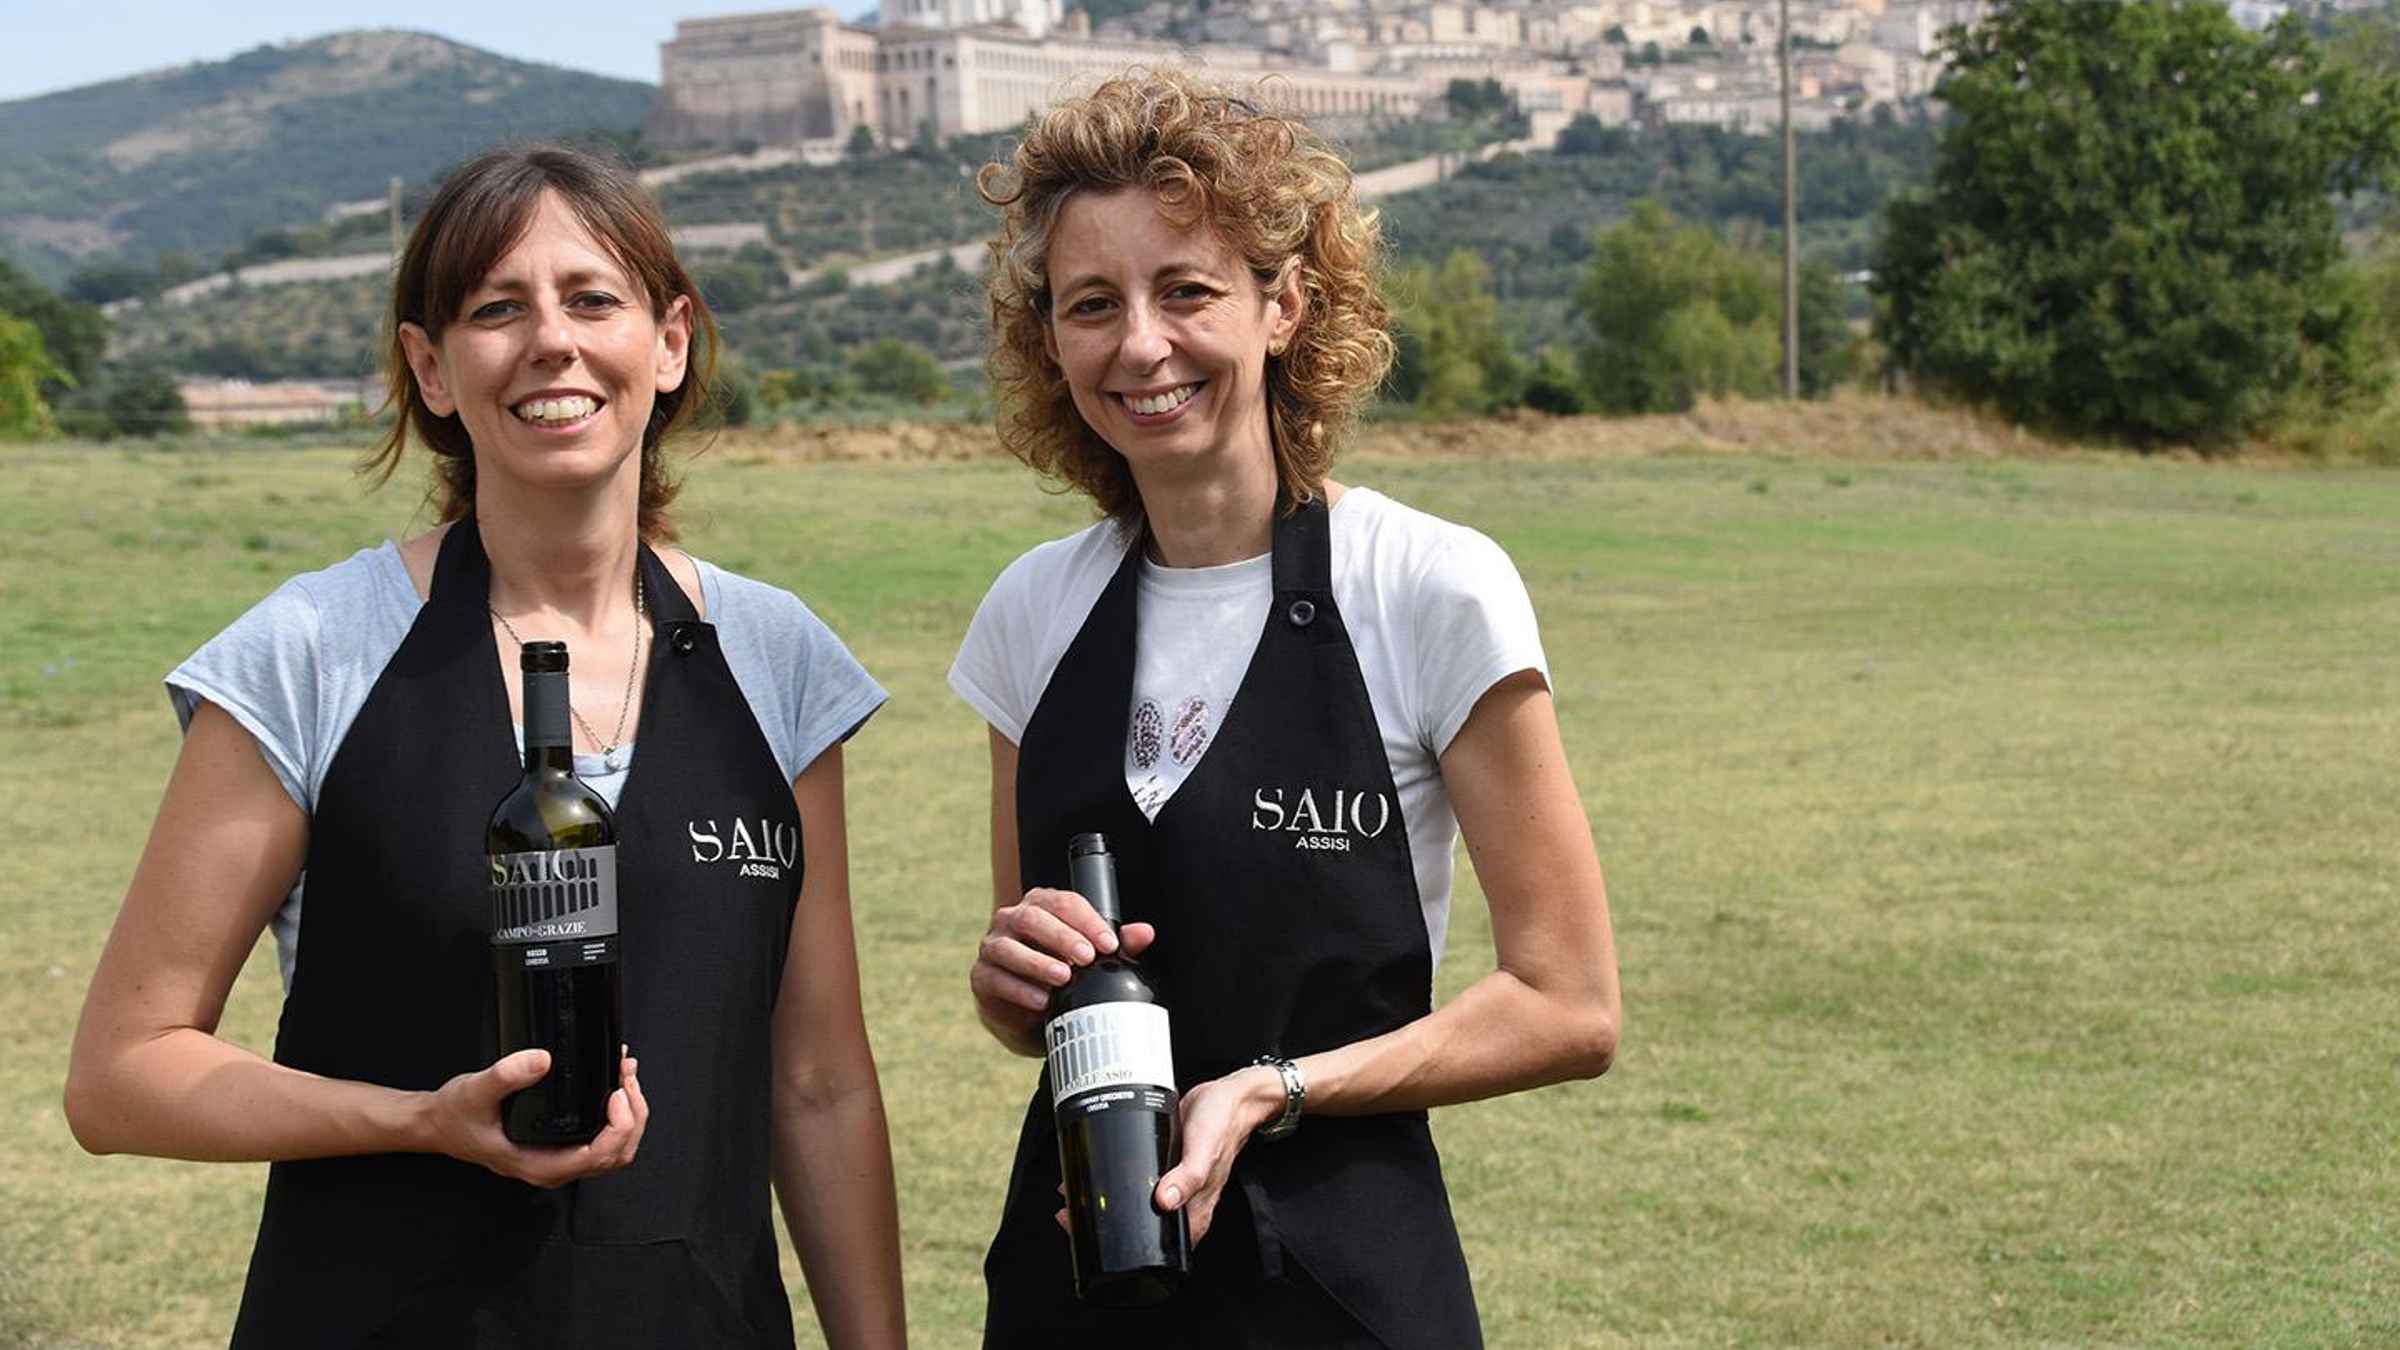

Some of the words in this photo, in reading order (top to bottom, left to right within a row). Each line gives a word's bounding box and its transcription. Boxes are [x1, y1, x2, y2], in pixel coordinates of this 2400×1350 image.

[1252, 788, 1389, 838] SAIO
[688, 817, 797, 869] SAIO
[1296, 836, 1350, 852] ASSISI
[491, 850, 580, 887] SAIO
[739, 863, 780, 880] ASSISI
